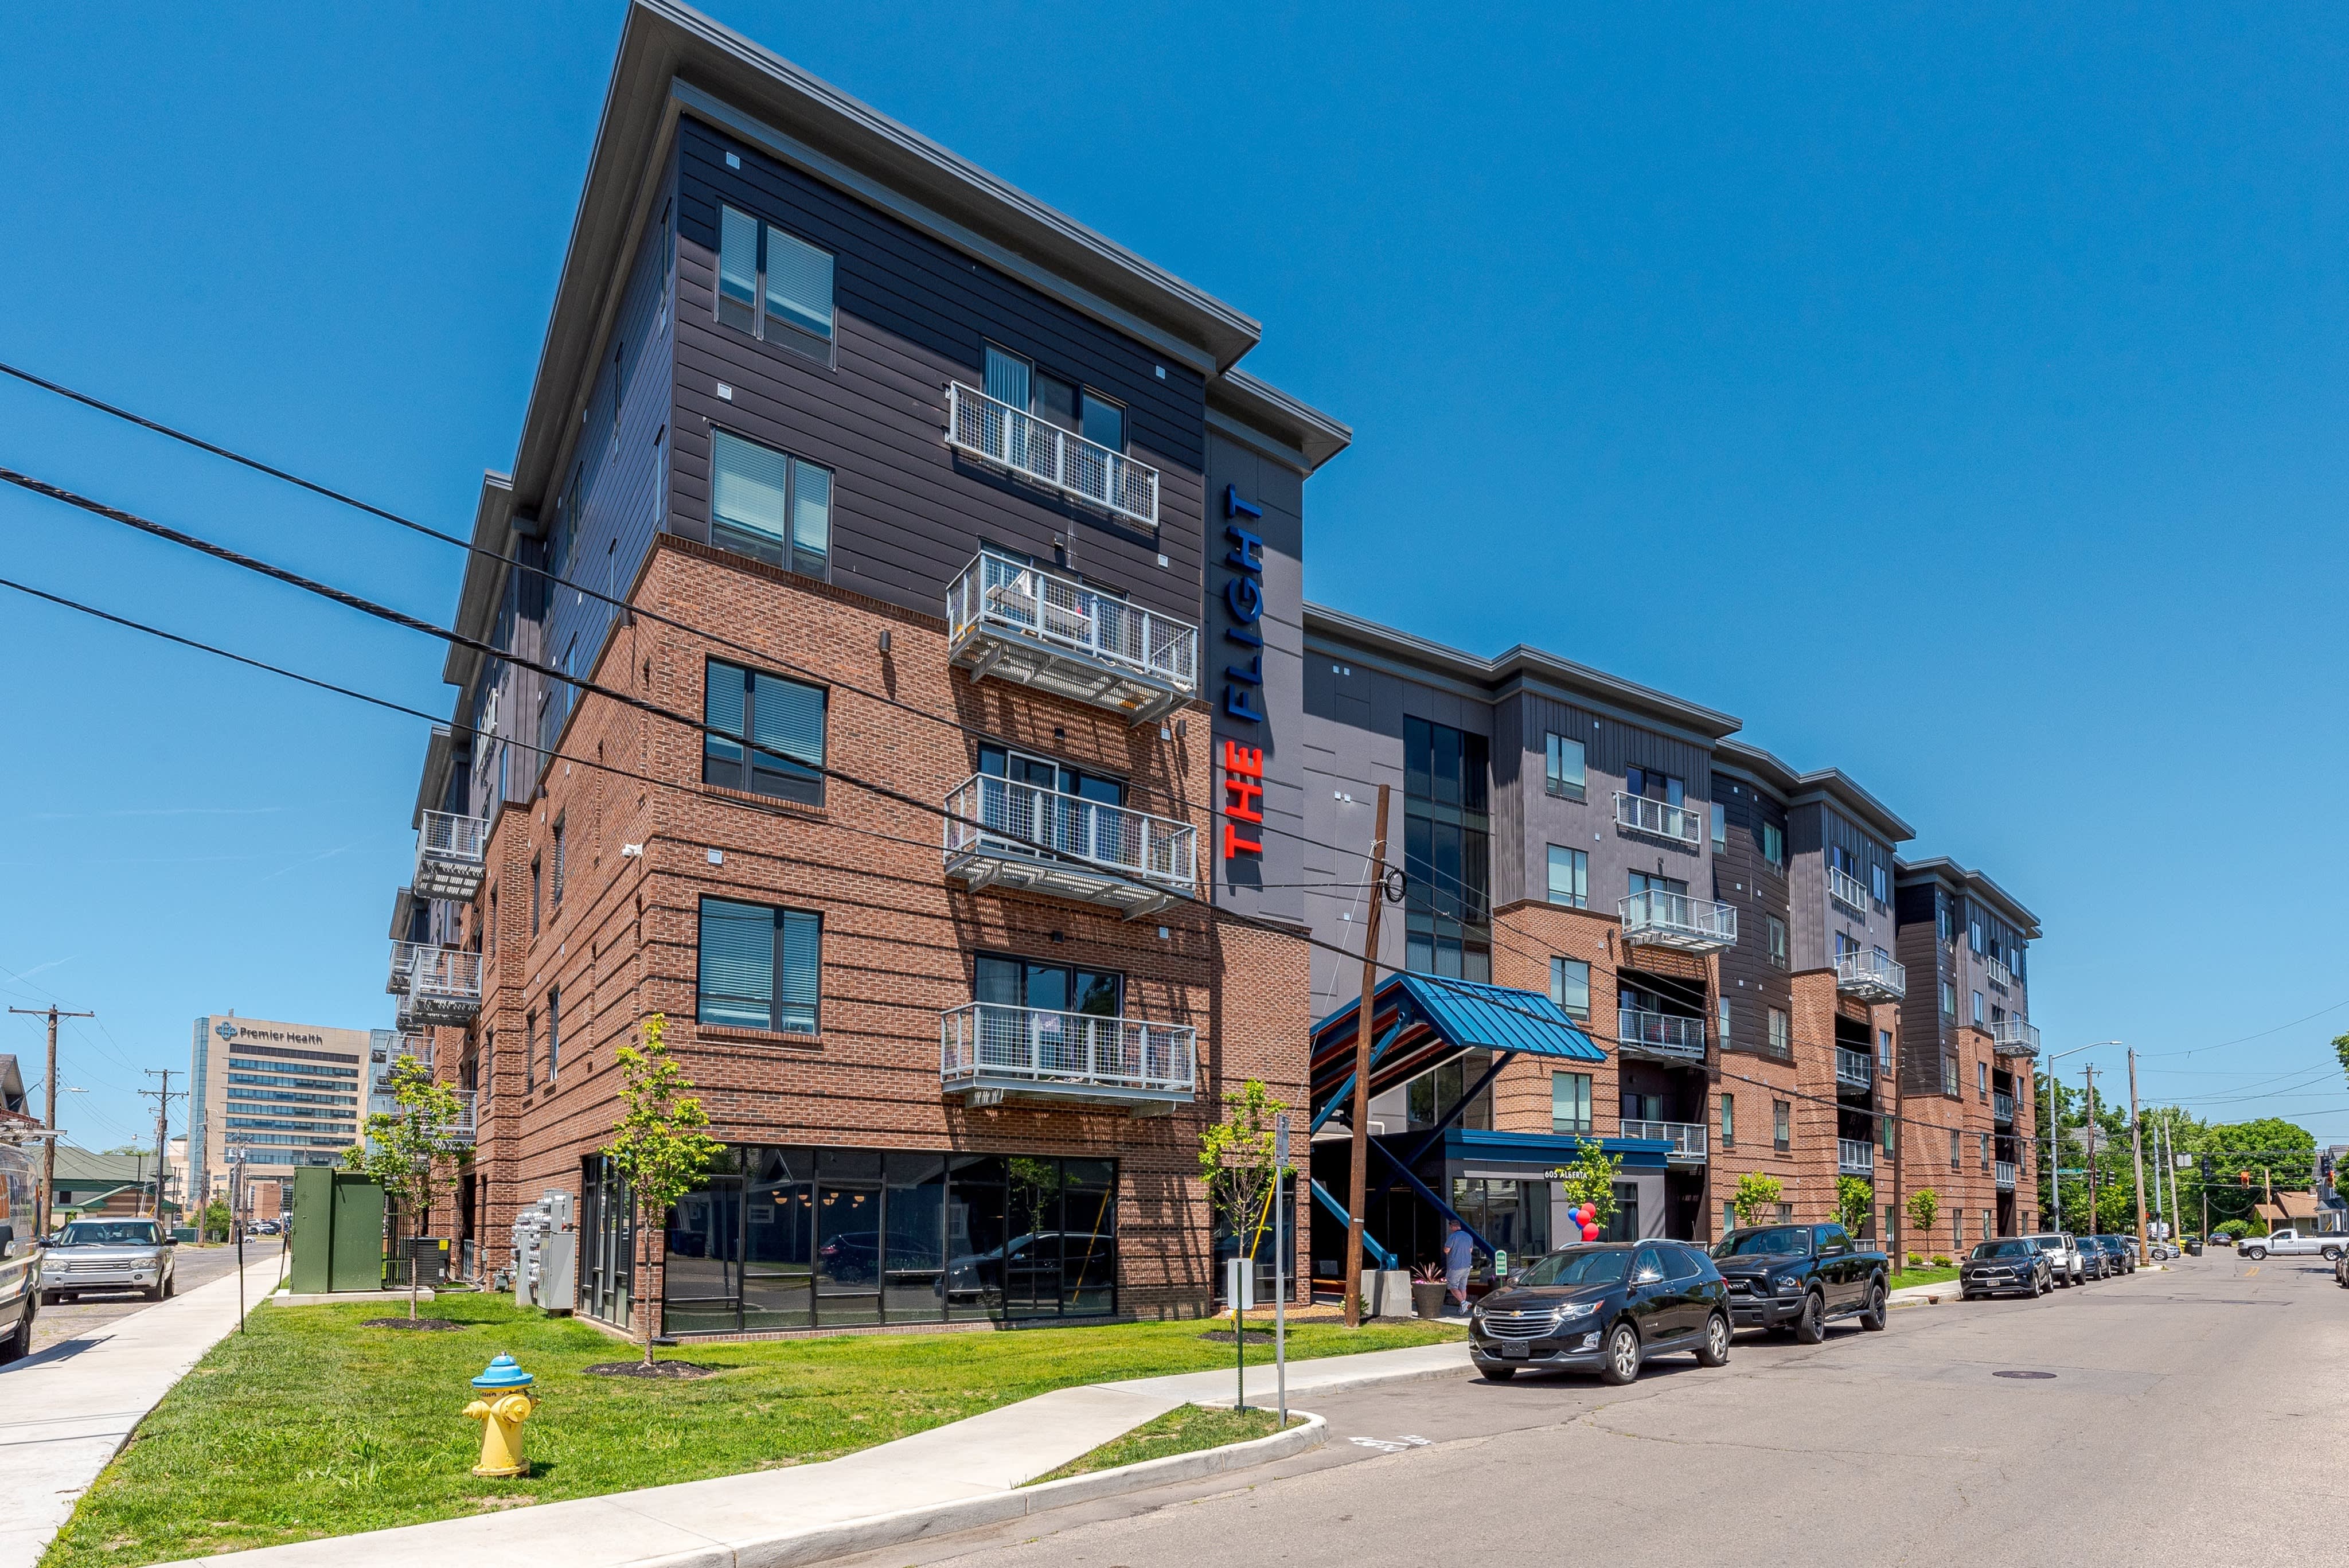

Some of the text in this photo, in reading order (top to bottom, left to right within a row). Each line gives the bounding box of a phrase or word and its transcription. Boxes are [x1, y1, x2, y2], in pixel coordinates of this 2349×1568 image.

[1225, 483, 1263, 859] THE FLIGHT
[240, 1027, 322, 1045] Premier Health
[1544, 1171, 1587, 1179] 605 ALBERTA
